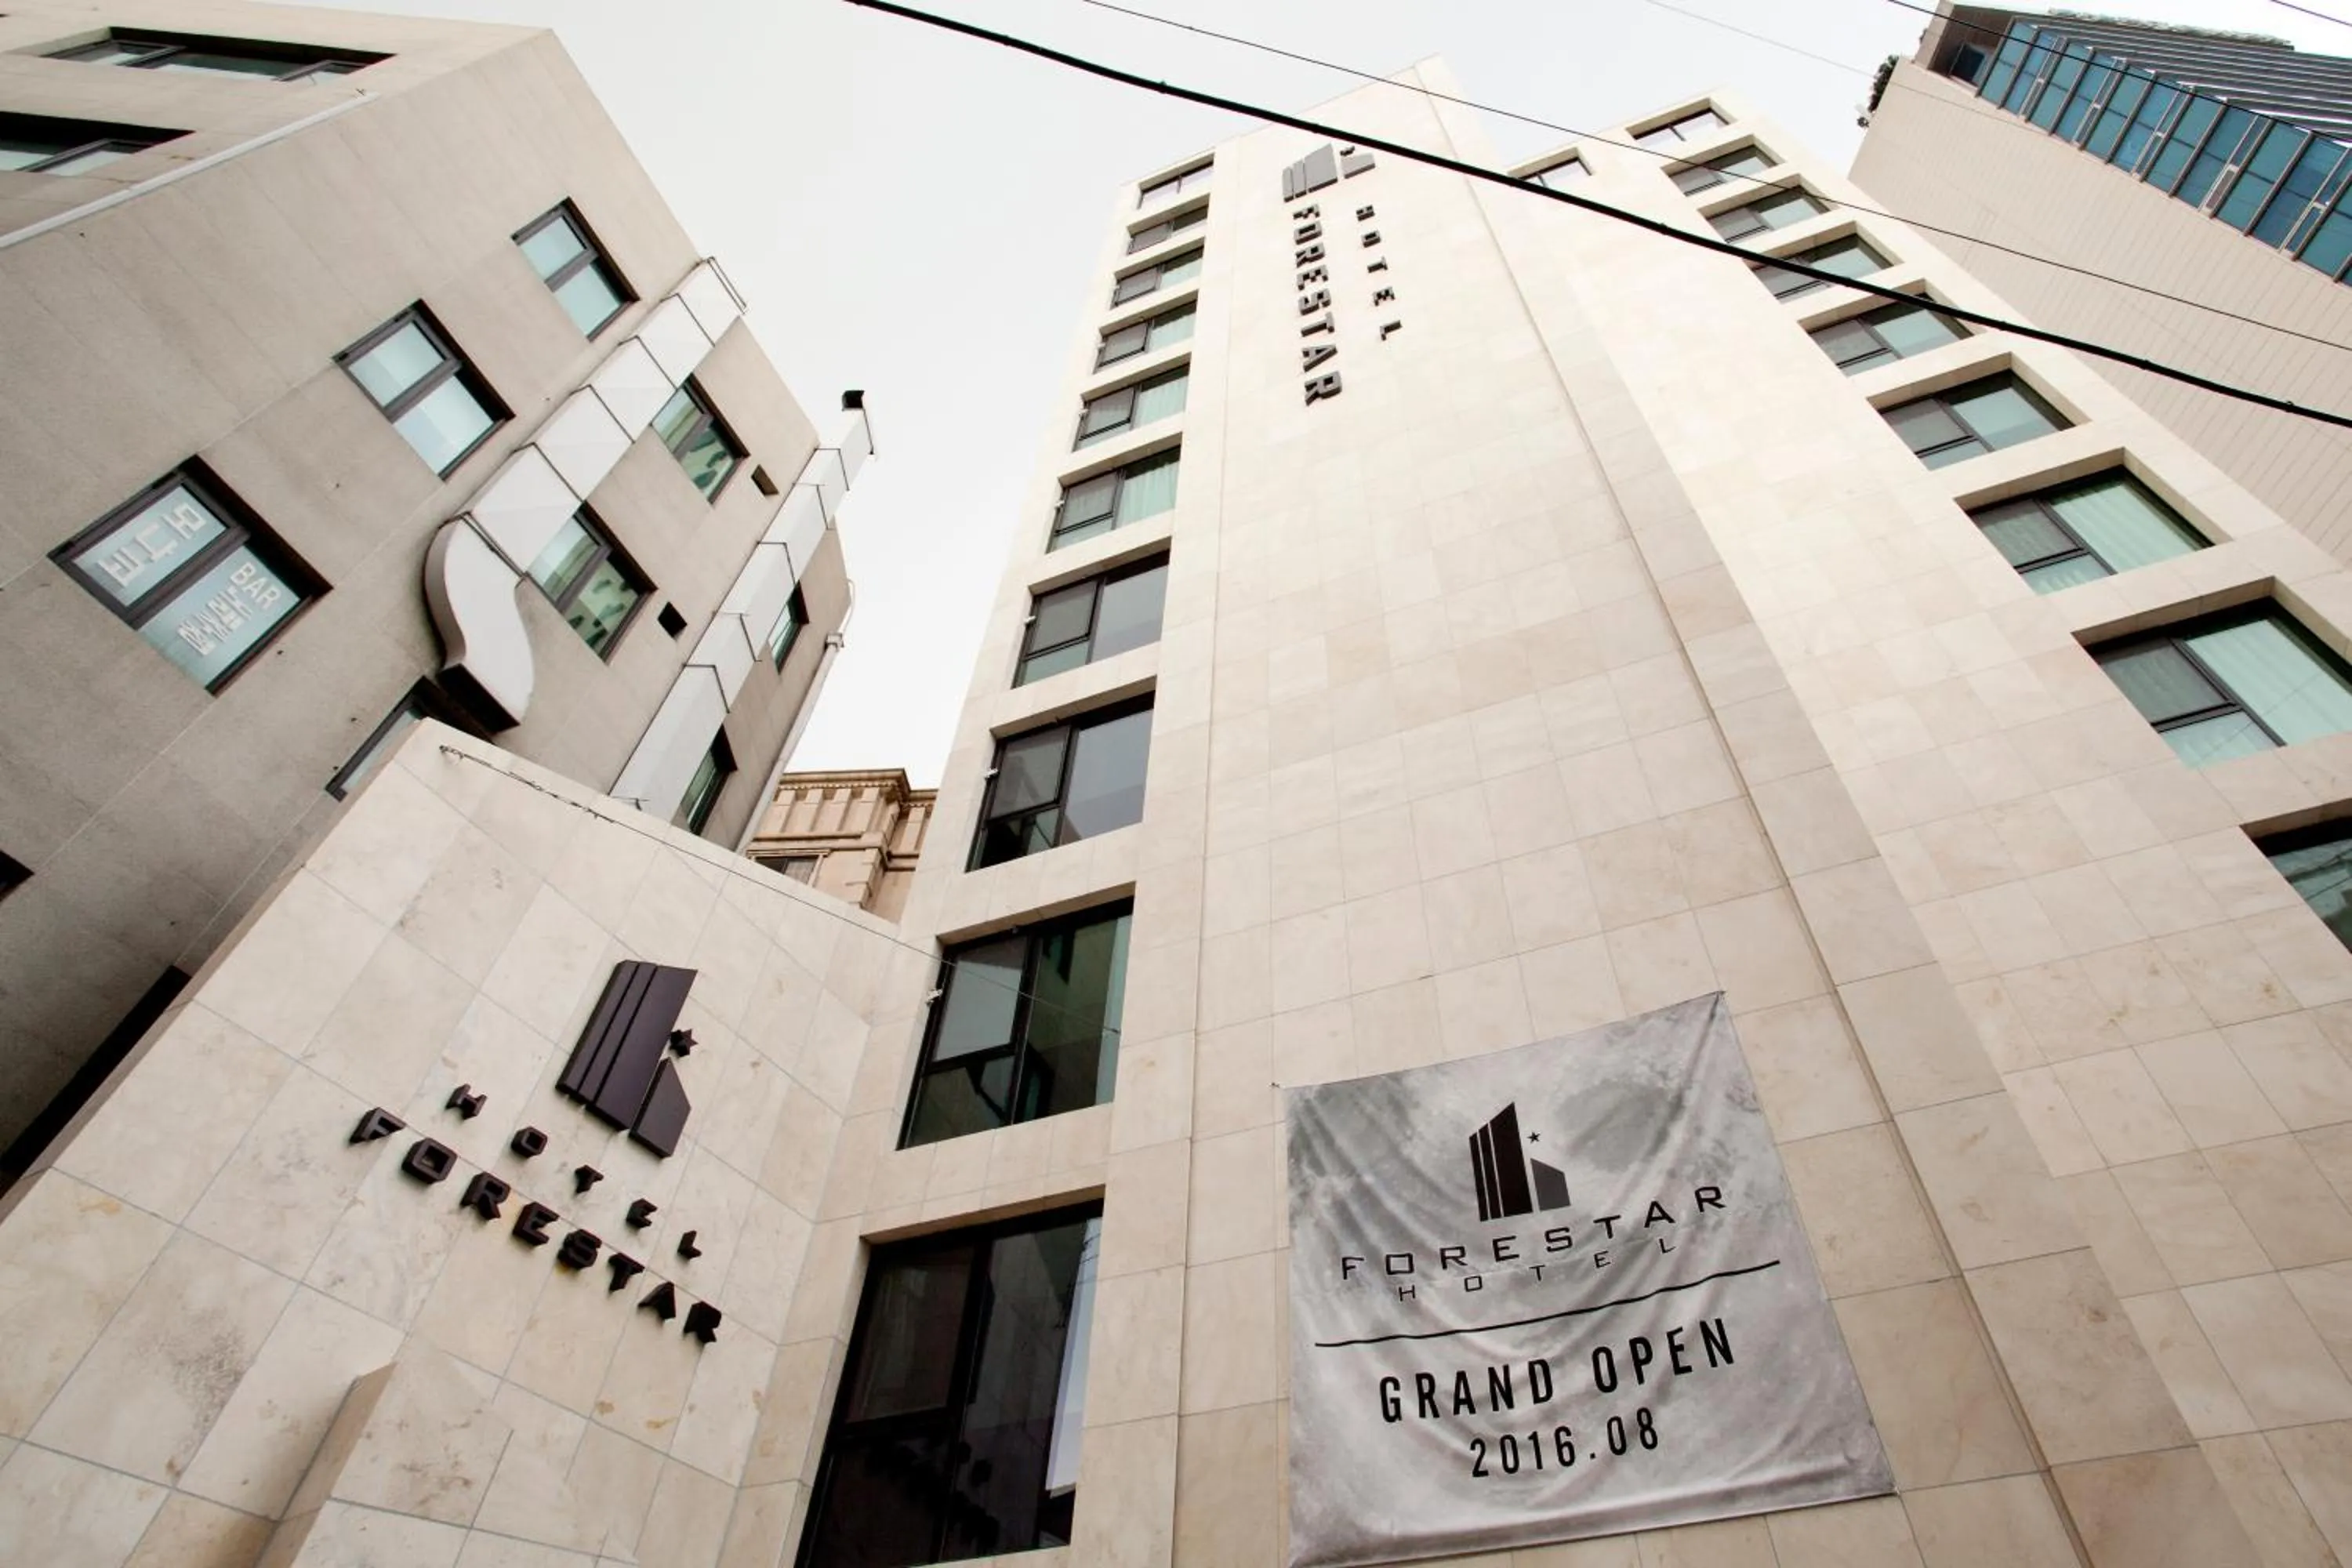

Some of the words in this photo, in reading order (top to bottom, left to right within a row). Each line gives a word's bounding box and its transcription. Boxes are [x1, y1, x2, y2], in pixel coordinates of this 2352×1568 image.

[1293, 203, 1343, 407] FORESTAR
[1356, 204, 1403, 342] HOTEL
[97, 503, 206, 587] 모나코
[230, 562, 281, 610] BAR
[177, 586, 252, 655] 노래주점
[445, 1083, 702, 1263] HOTEL
[349, 1107, 722, 1344] FORESTAR
[1341, 1185, 1727, 1281] FORESTAR
[1398, 1237, 1676, 1303] HOTEL
[1379, 1358, 1554, 1424] GRAND
[1592, 1317, 1736, 1395] OPEN
[1469, 1406, 1659, 1479] 2016.08
